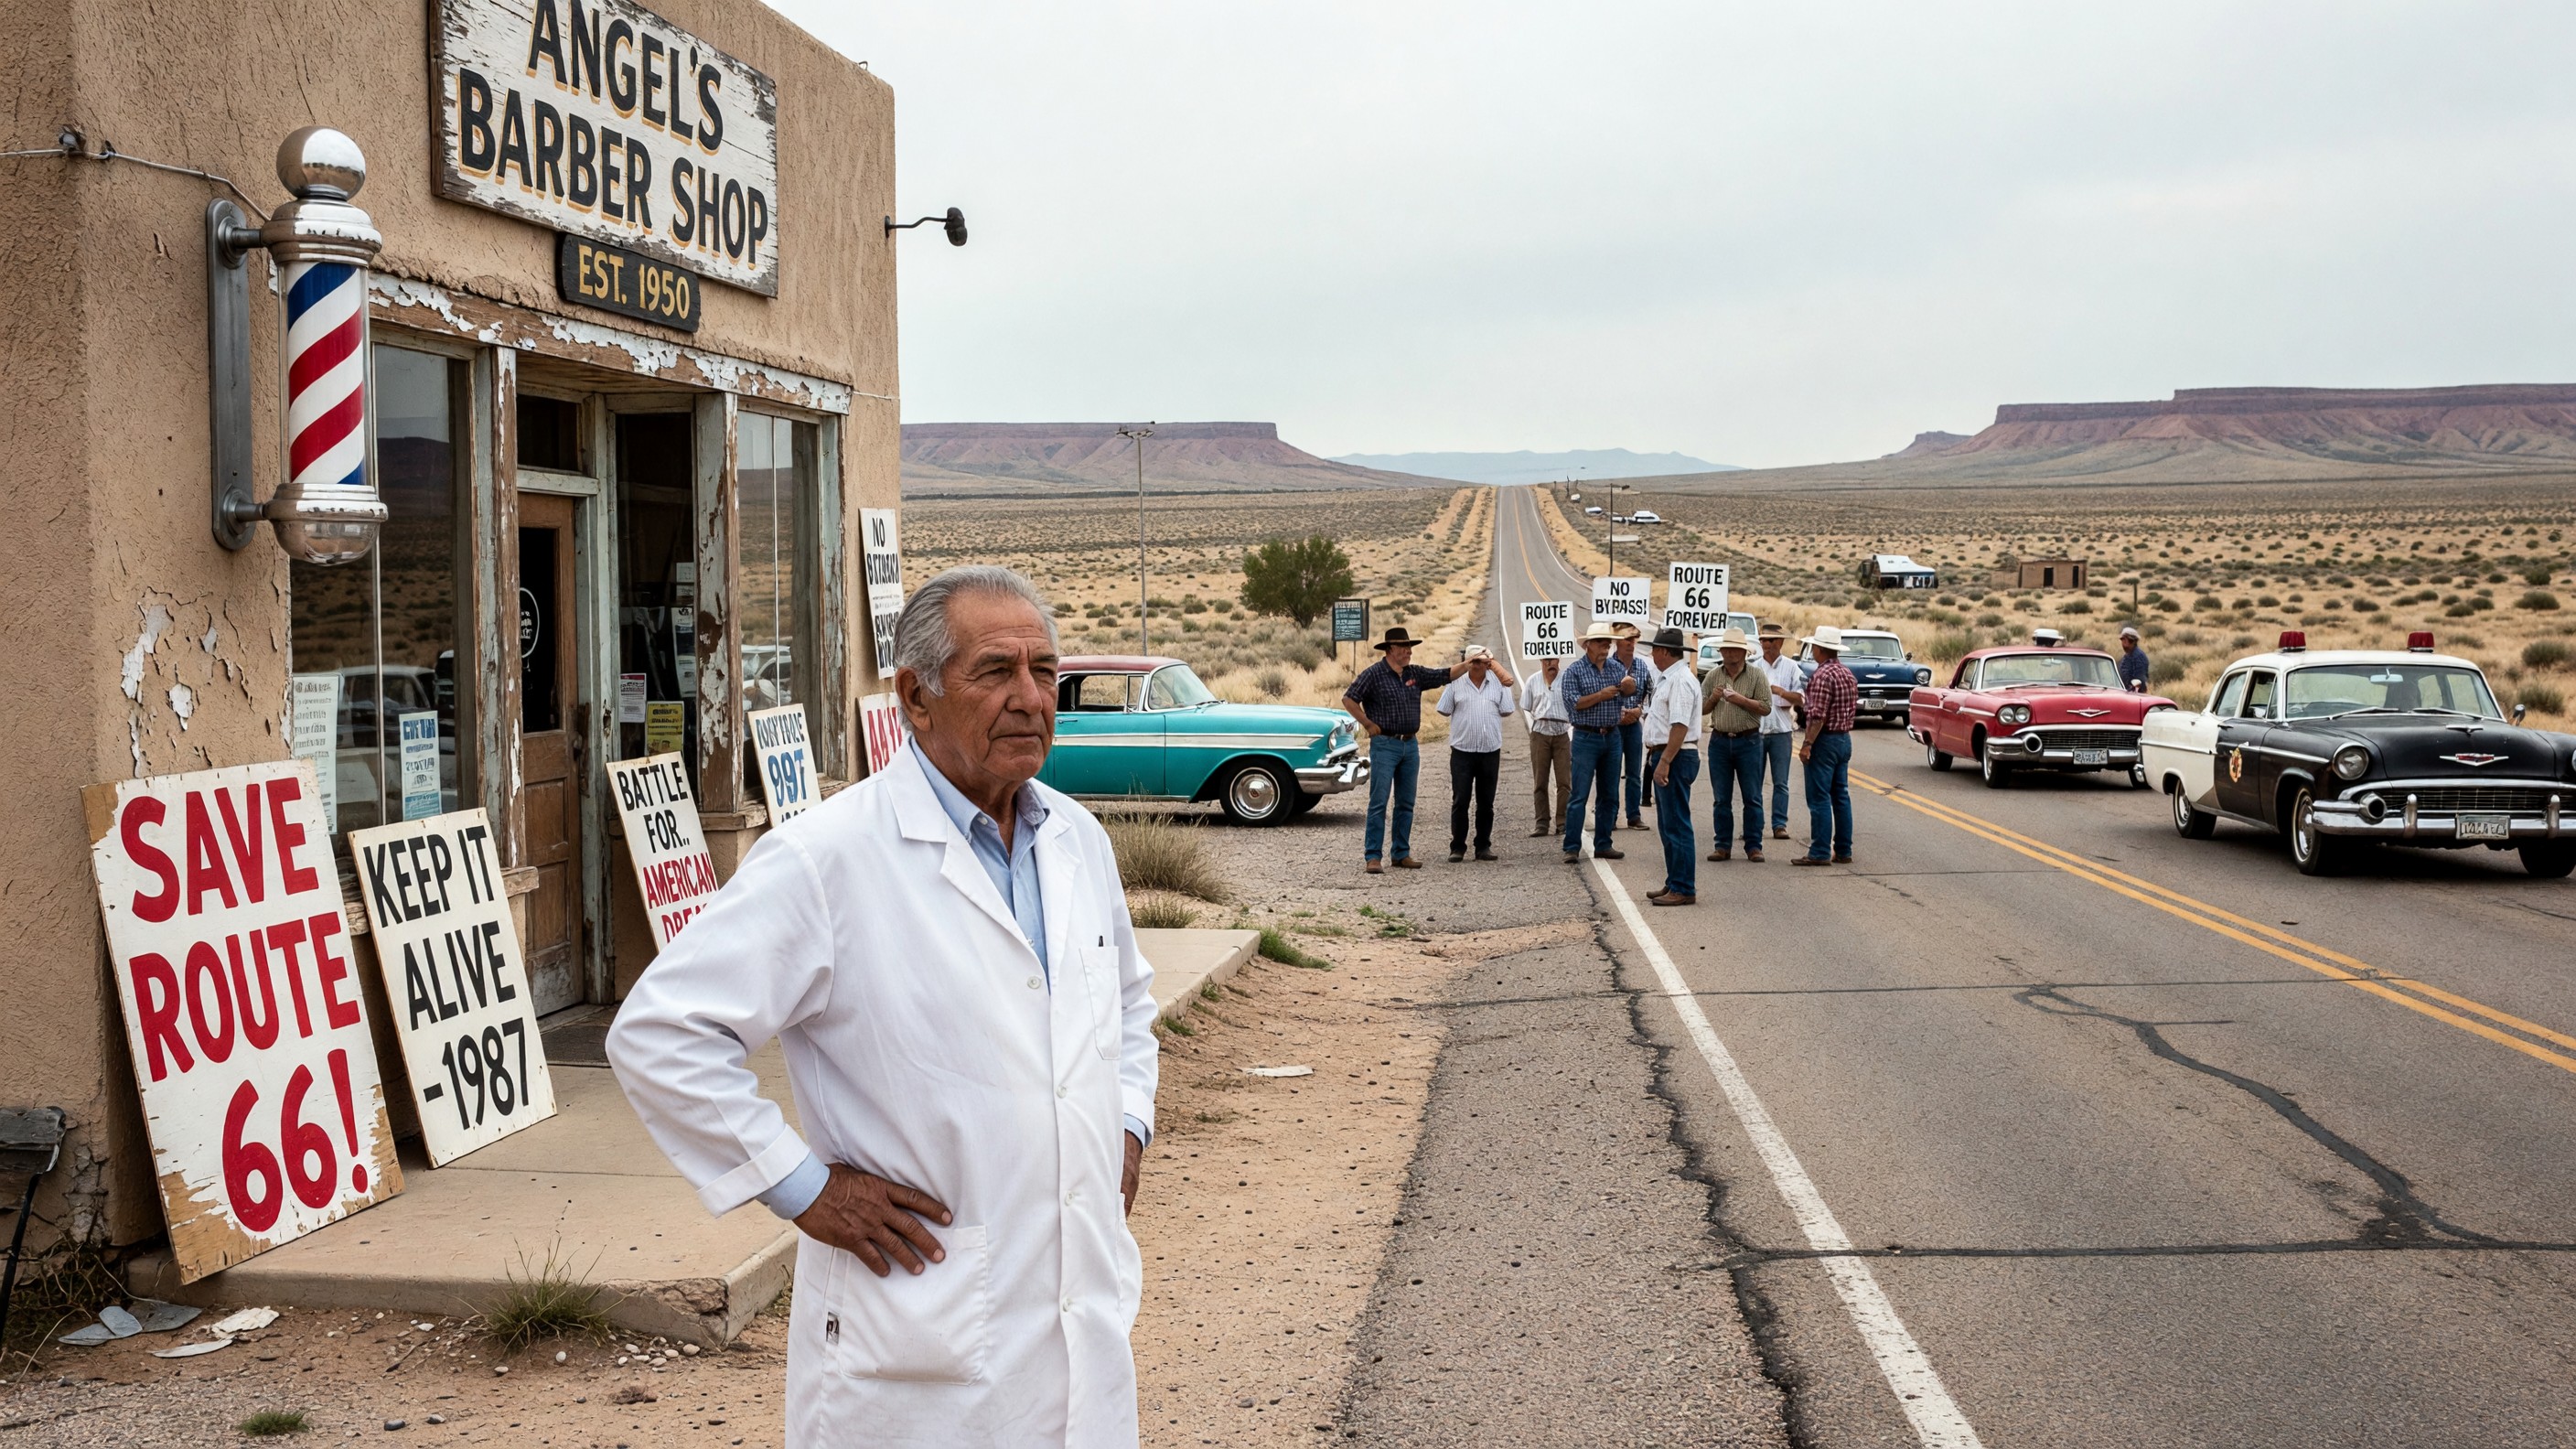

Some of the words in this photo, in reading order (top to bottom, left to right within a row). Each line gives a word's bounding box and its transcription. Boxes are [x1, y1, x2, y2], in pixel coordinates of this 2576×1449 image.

[526, 0, 723, 155] ANGEL'S
[457, 68, 652, 234] BARBER
[671, 156, 768, 270] SHOP
[578, 244, 627, 305] EST.
[639, 263, 691, 319] 1950
[872, 517, 886, 548] NO
[1610, 581, 1630, 596] NO
[1674, 566, 1723, 585] ROUTE
[1684, 586, 1710, 609] 66
[1526, 604, 1568, 620] ROUTE
[1537, 621, 1558, 639] 66
[1595, 598, 1648, 615] BYPASS!
[1666, 609, 1728, 629] FOREVER
[1524, 640, 1573, 656] FOREVER
[617, 761, 688, 811] BATTLE
[120, 777, 318, 923] SAVE
[362, 833, 452, 928] KEEP
[457, 824, 495, 905] IT
[642, 852, 718, 909] AMERICAN
[129, 911, 360, 1082] ROUTE
[402, 920, 515, 1031] ALIVE
[423, 1017, 529, 1131] -1987
[221, 1047, 369, 1233] 66!
